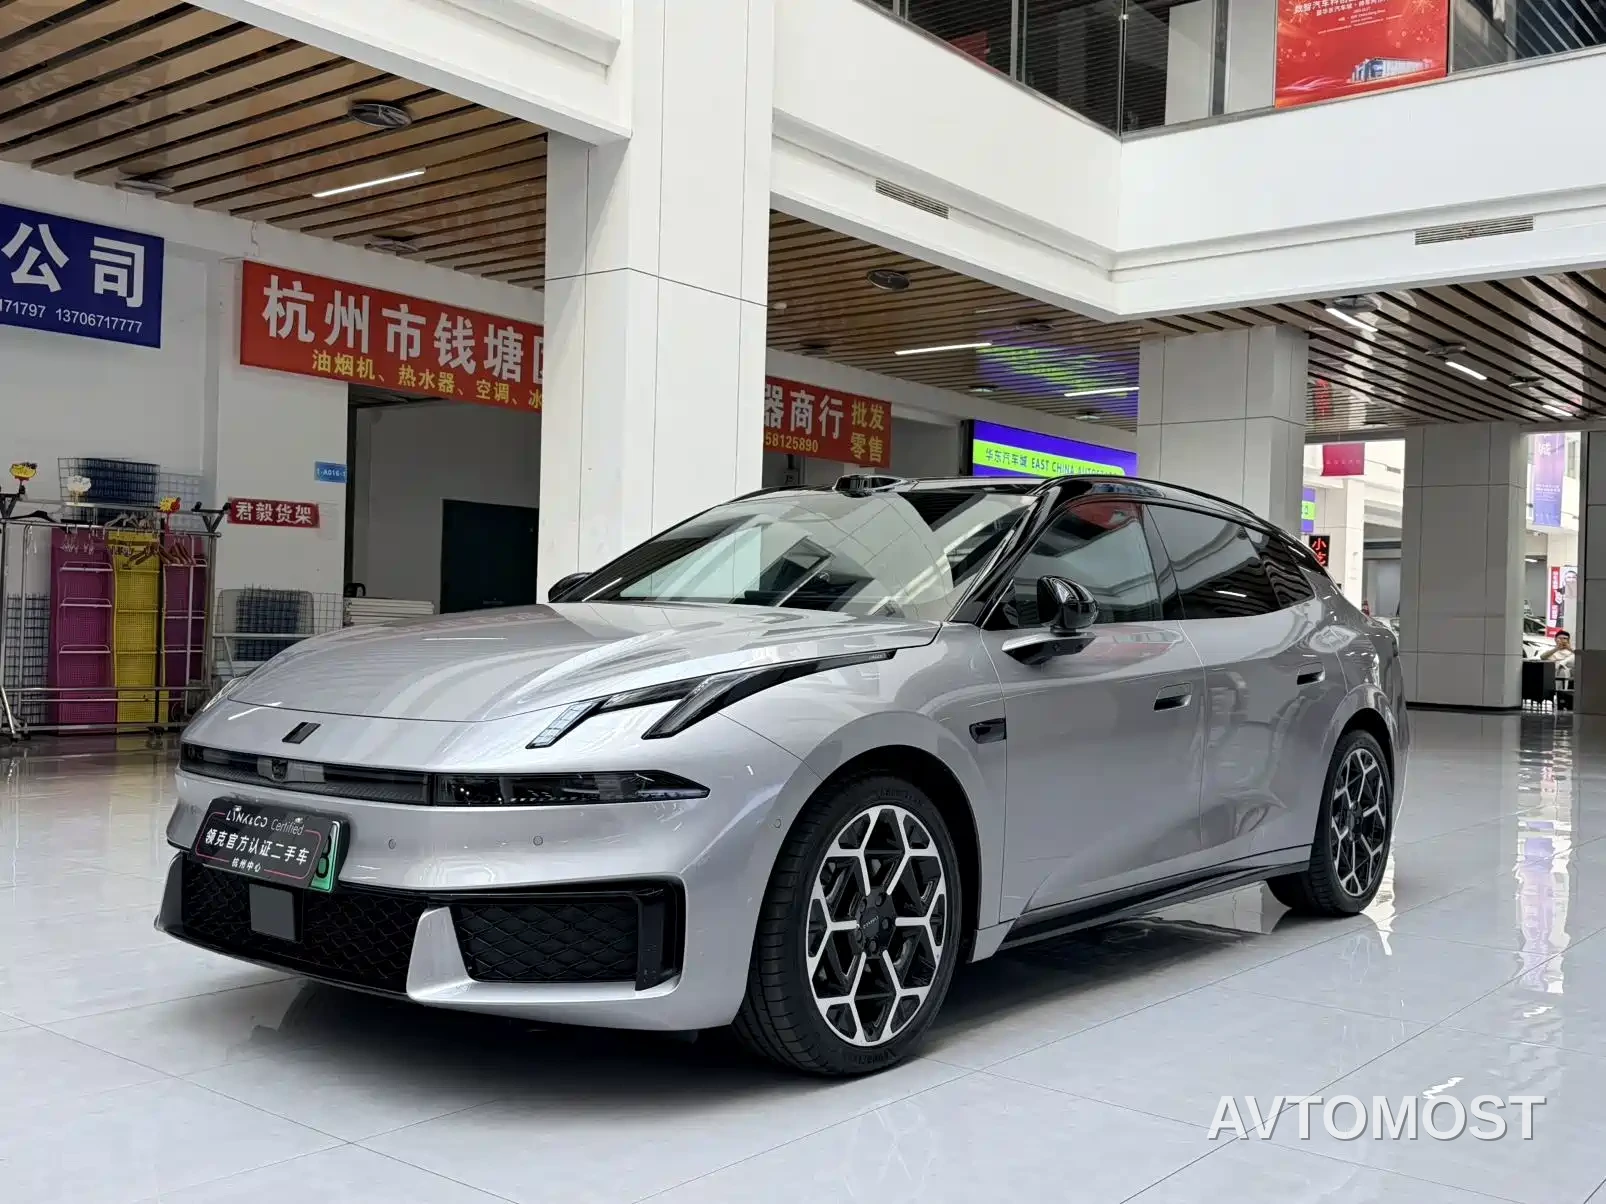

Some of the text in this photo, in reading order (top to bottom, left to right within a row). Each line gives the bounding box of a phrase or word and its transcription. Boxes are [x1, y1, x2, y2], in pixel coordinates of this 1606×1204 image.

[1, 223, 144, 308] 公司
[56, 308, 143, 334] 13706717777
[262, 274, 543, 385] 杭州市钱塘
[851, 399, 884, 430] 批发
[850, 432, 883, 463] 零售
[1031, 457, 1050, 471] EAST
[1051, 461, 1075, 475] CHINA
[236, 501, 312, 525] 君毅货架
[271, 818, 305, 836] Certified
[205, 827, 310, 866] 领克官方认证二手车
[231, 857, 261, 873] 杭州中心
